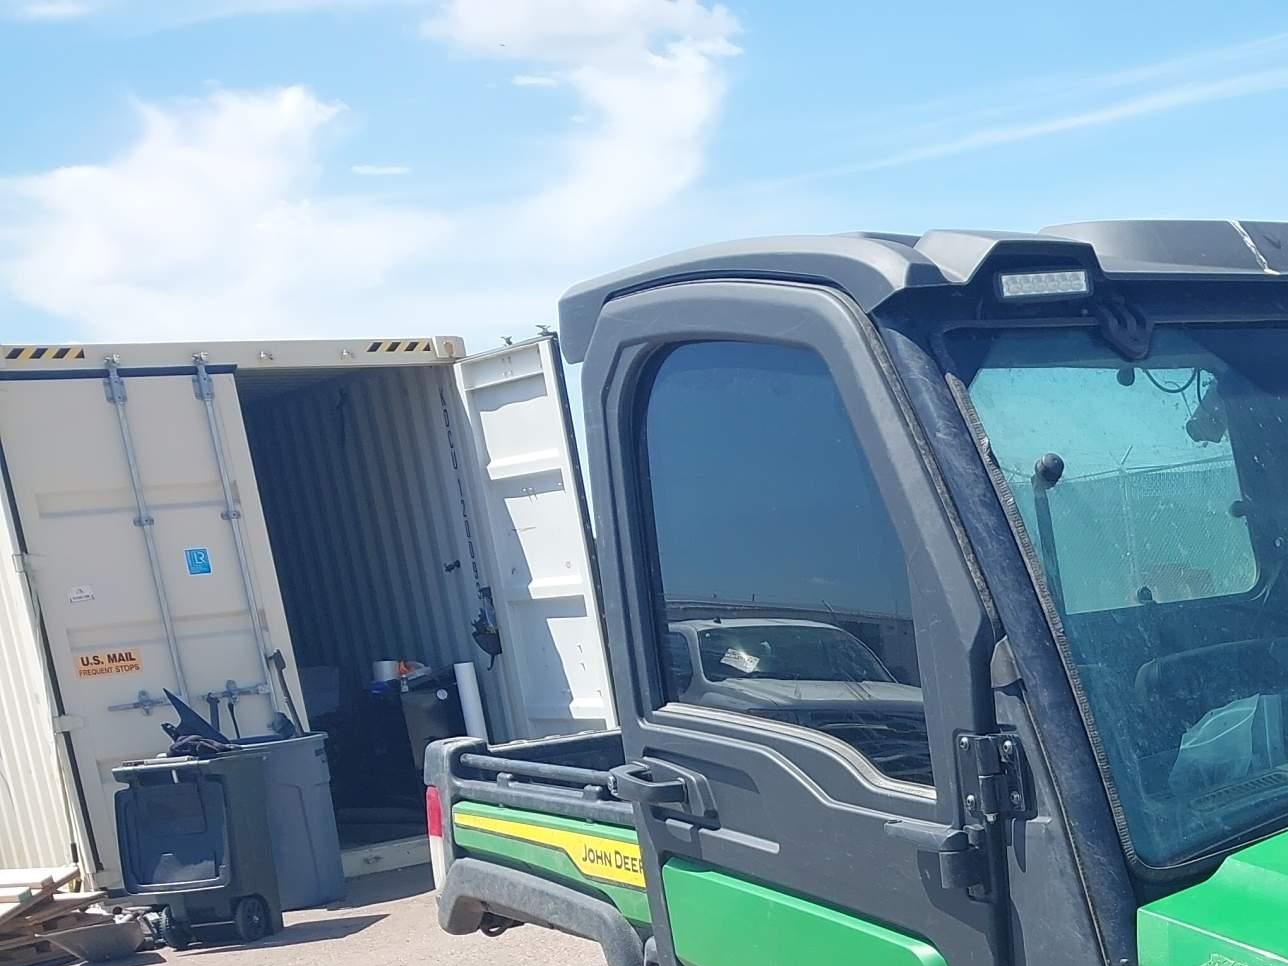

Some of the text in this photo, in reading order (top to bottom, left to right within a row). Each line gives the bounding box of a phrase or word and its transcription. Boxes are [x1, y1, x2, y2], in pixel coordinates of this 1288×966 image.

[80, 652, 137, 667] U.S. MAIL
[79, 663, 140, 678] FREQUENT STOPS
[582, 843, 613, 868] JOHN
